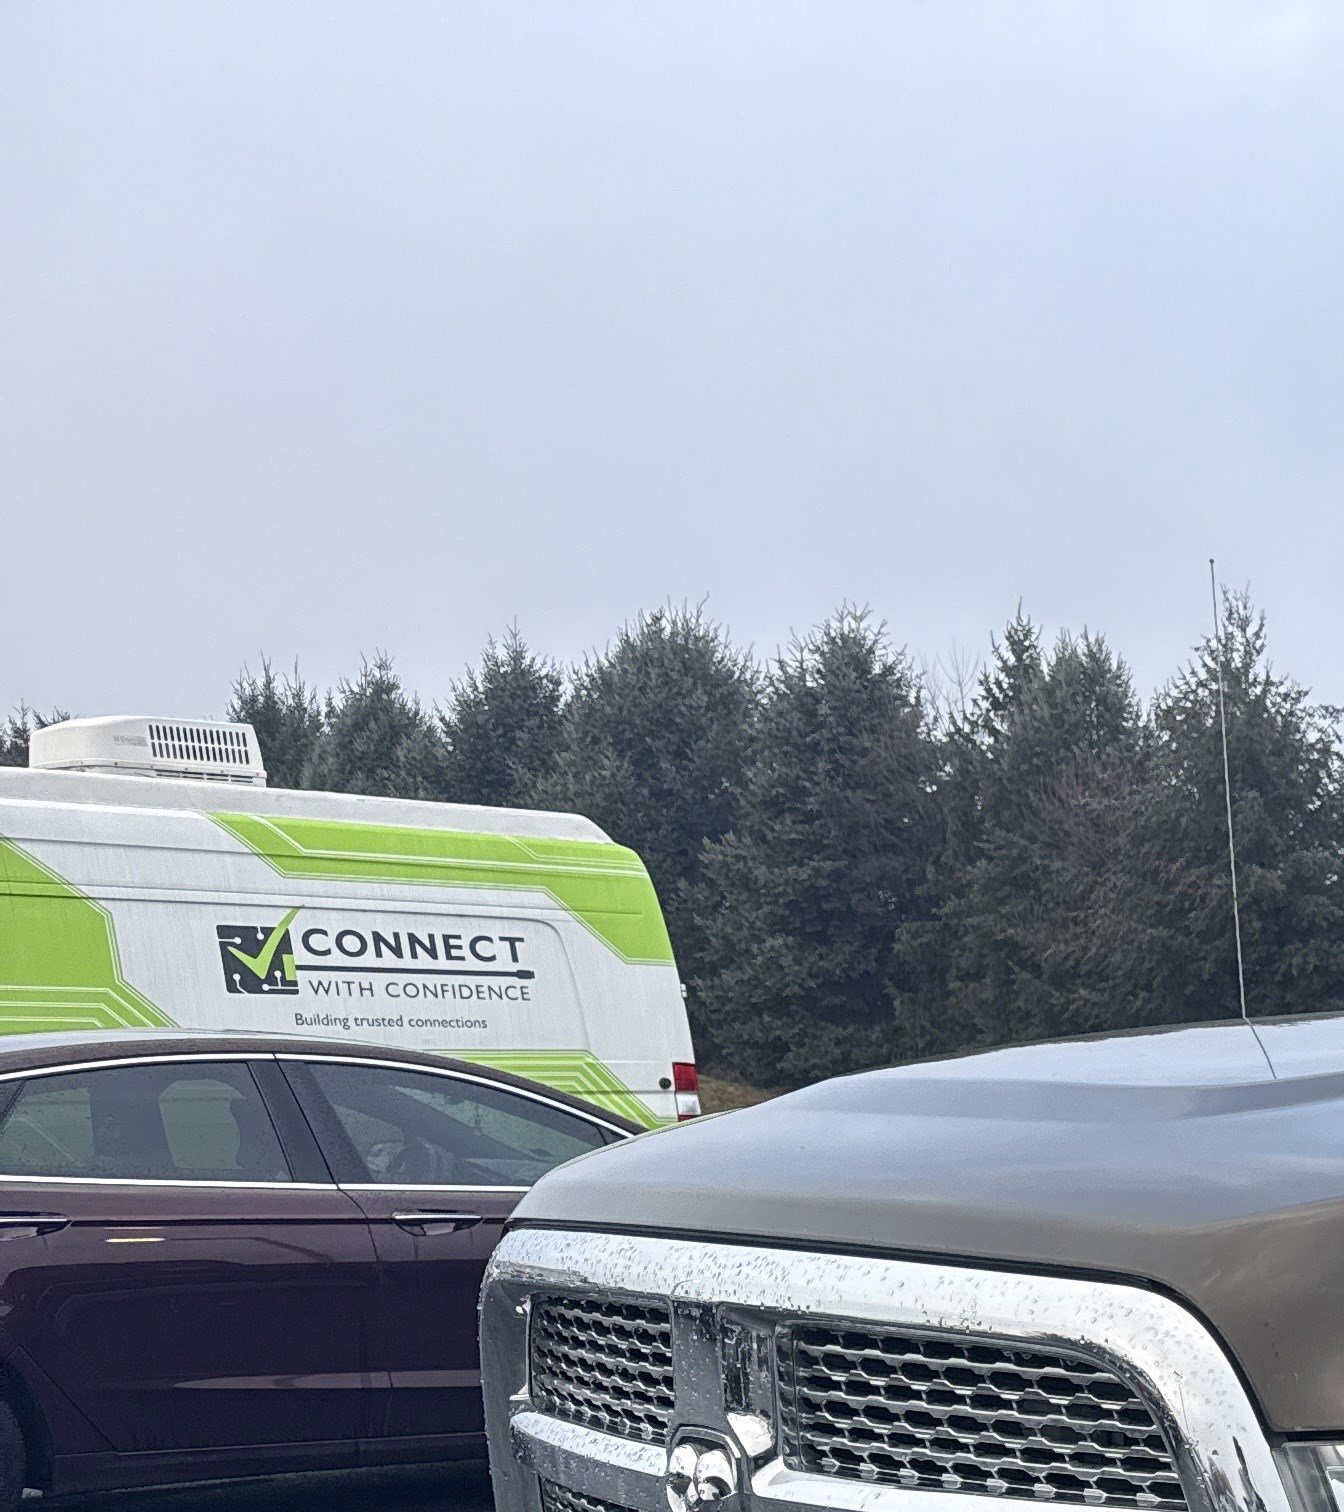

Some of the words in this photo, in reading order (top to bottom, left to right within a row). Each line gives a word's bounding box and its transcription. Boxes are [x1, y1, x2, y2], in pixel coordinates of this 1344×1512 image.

[301, 927, 525, 963] CONNECT
[309, 979, 375, 998] WITH
[384, 982, 531, 1001] CONFIDENCE
[294, 1013, 350, 1030] Building
[354, 1015, 404, 1028] trusted
[407, 1016, 488, 1029] connections
